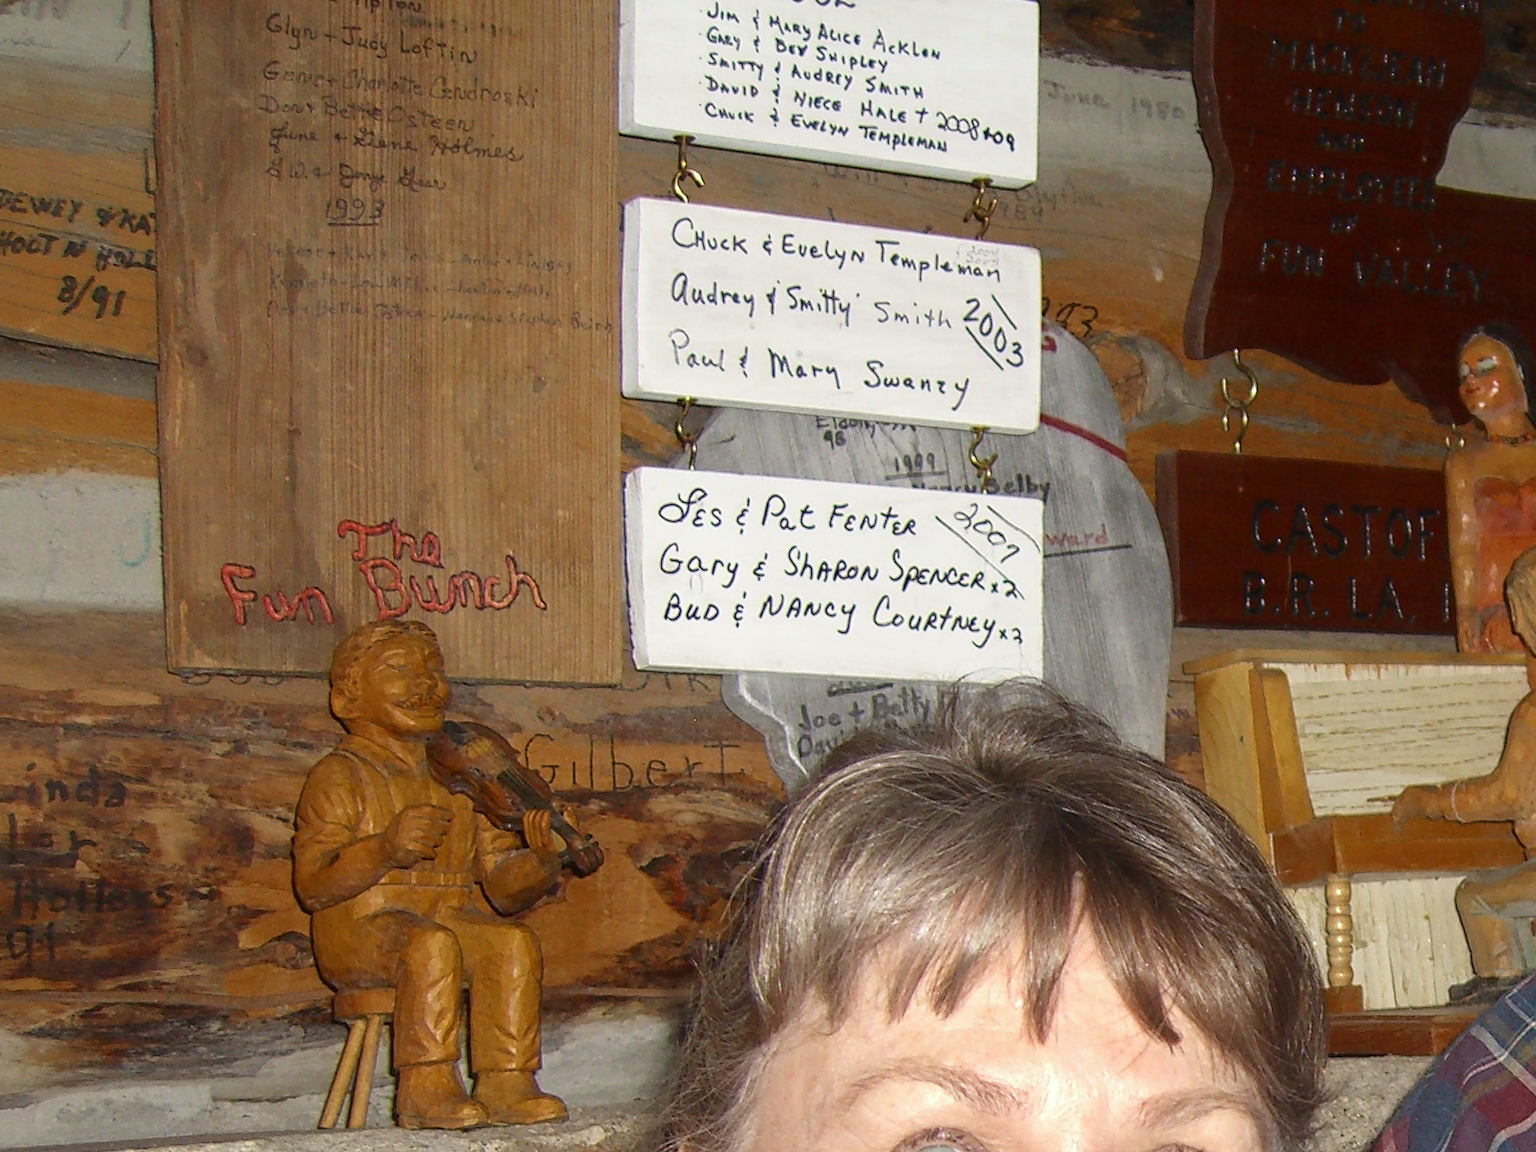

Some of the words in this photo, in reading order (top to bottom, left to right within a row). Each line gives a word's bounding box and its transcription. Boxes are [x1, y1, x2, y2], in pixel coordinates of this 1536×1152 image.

[1258, 238, 1326, 278] FUN
[1354, 250, 1490, 302] VALLEY
[874, 301, 952, 329] Smith
[668, 328, 726, 373] Paul
[768, 347, 841, 390] Mary
[762, 493, 817, 531] Pat
[337, 519, 444, 569] The
[659, 543, 739, 589] Gary
[220, 562, 334, 626] Fun
[360, 554, 548, 620] Bunch
